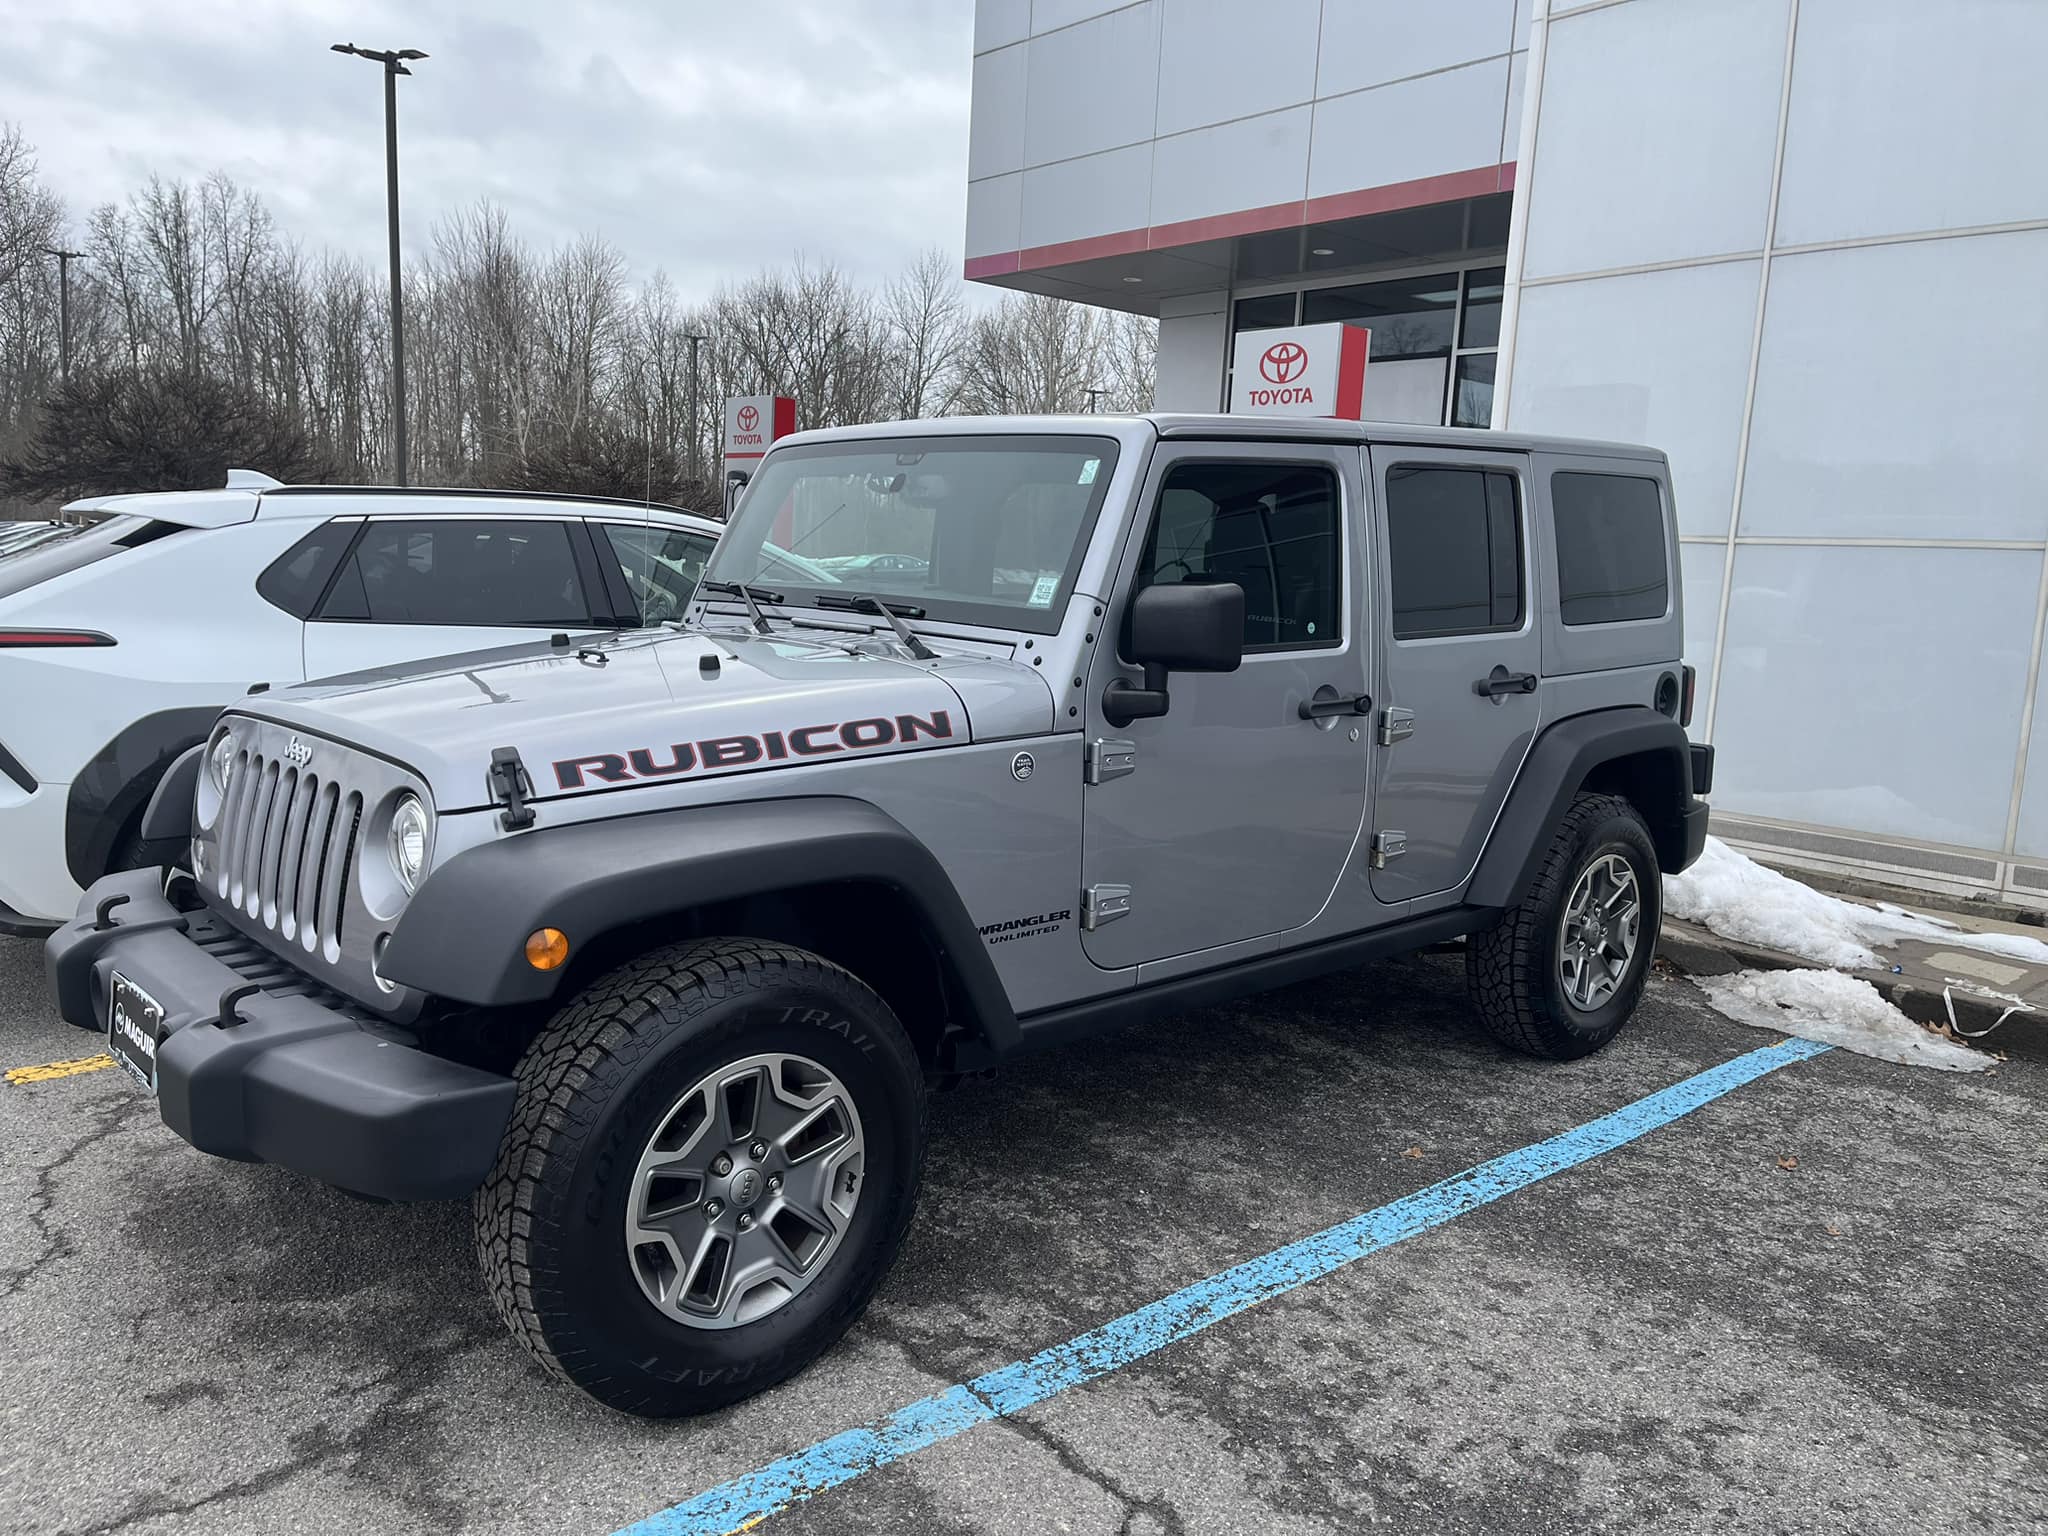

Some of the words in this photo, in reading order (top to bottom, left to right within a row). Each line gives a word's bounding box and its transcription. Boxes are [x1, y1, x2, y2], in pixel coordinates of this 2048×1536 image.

[1248, 387, 1313, 407] TOYOTA
[733, 434, 762, 445] TOYOTA
[284, 735, 312, 768] Jeep
[552, 710, 954, 790] RUBICON
[977, 909, 1072, 936] WRANGLER
[989, 924, 1060, 945] UNLIMITED
[124, 1016, 156, 1059] MAGUIR
[779, 1005, 878, 1062] TRAIL
